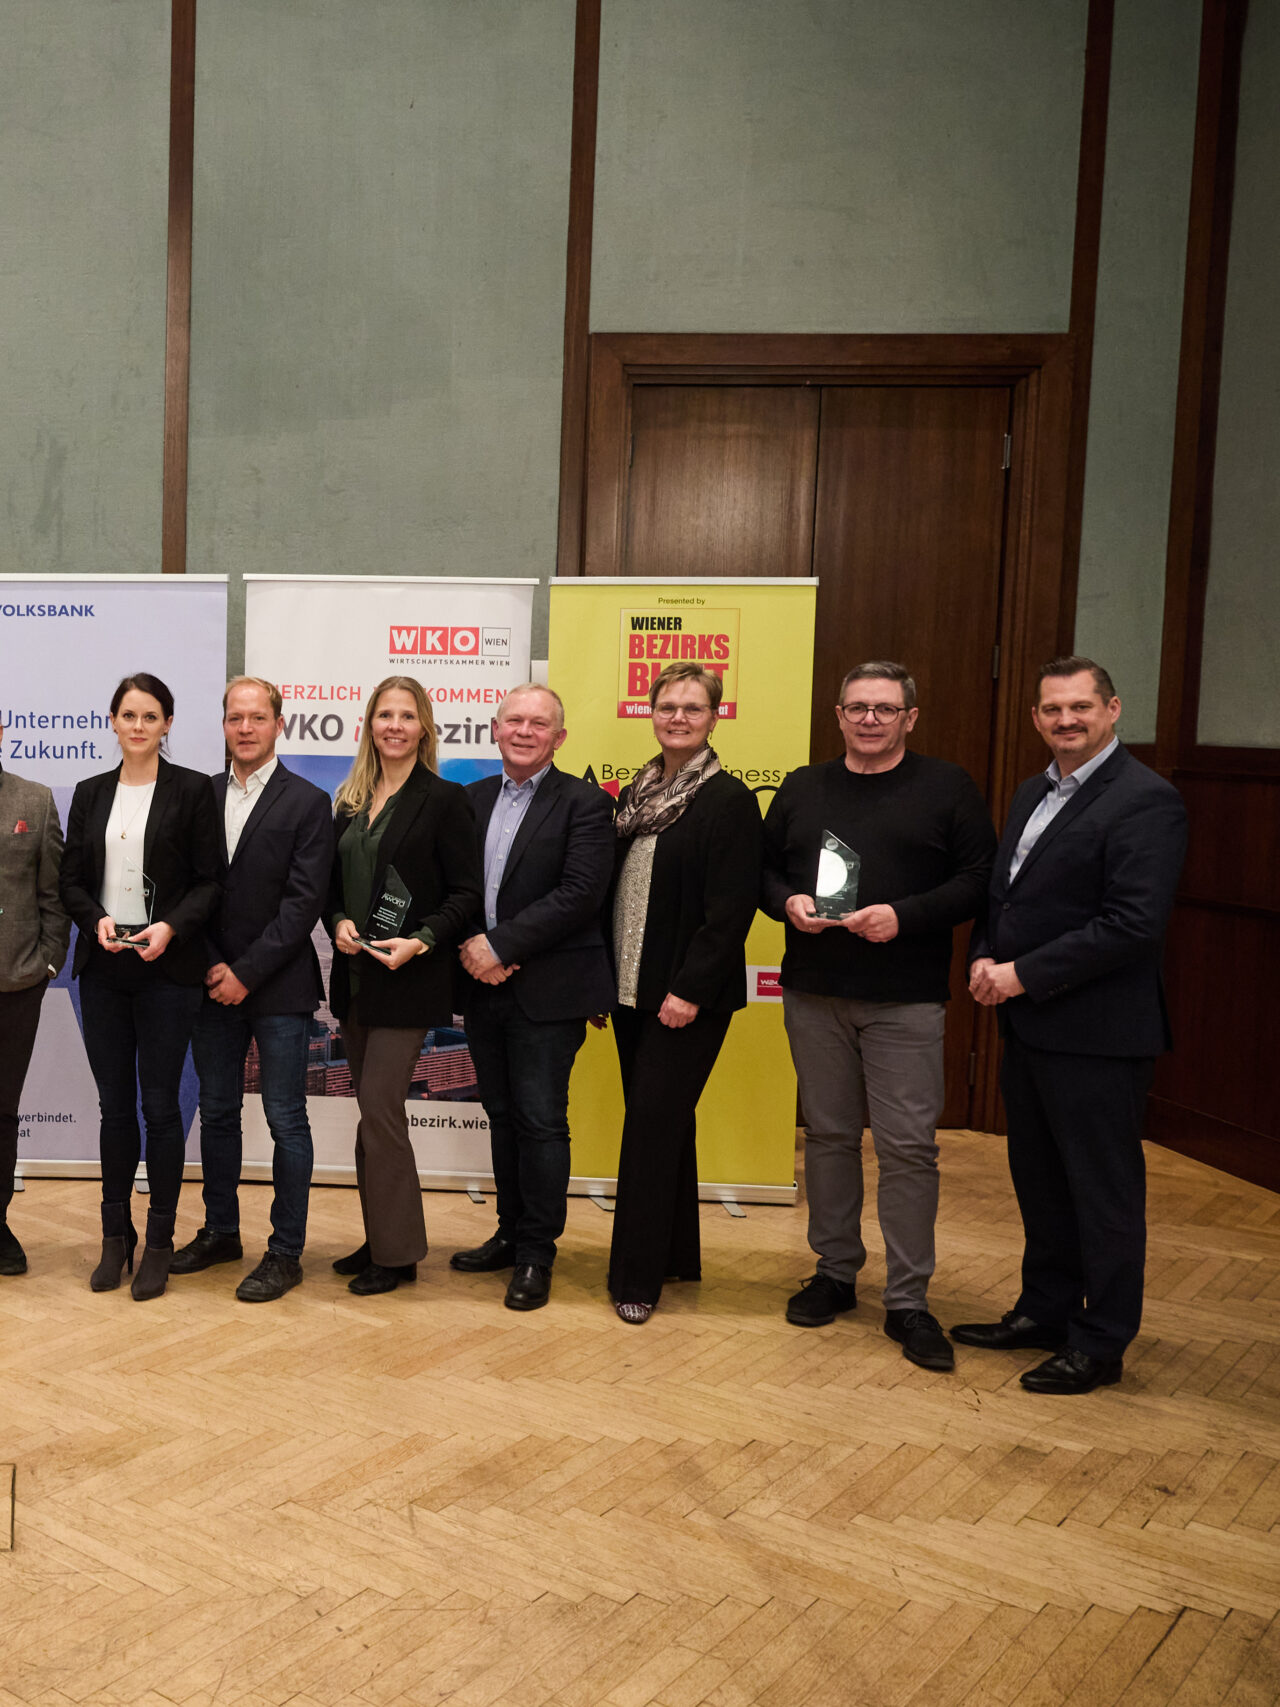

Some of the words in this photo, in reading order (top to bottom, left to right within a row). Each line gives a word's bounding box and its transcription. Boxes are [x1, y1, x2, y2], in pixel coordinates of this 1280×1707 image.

[631, 616, 683, 631] WIENER
[391, 629, 476, 652] WKO
[484, 638, 508, 646] WIEN
[628, 634, 730, 660] BEZIRKS
[389, 658, 486, 666] WIRTSCHAFTSKAMMER
[276, 684, 361, 701] ERZLICH
[10, 739, 103, 760] Zukunft.
